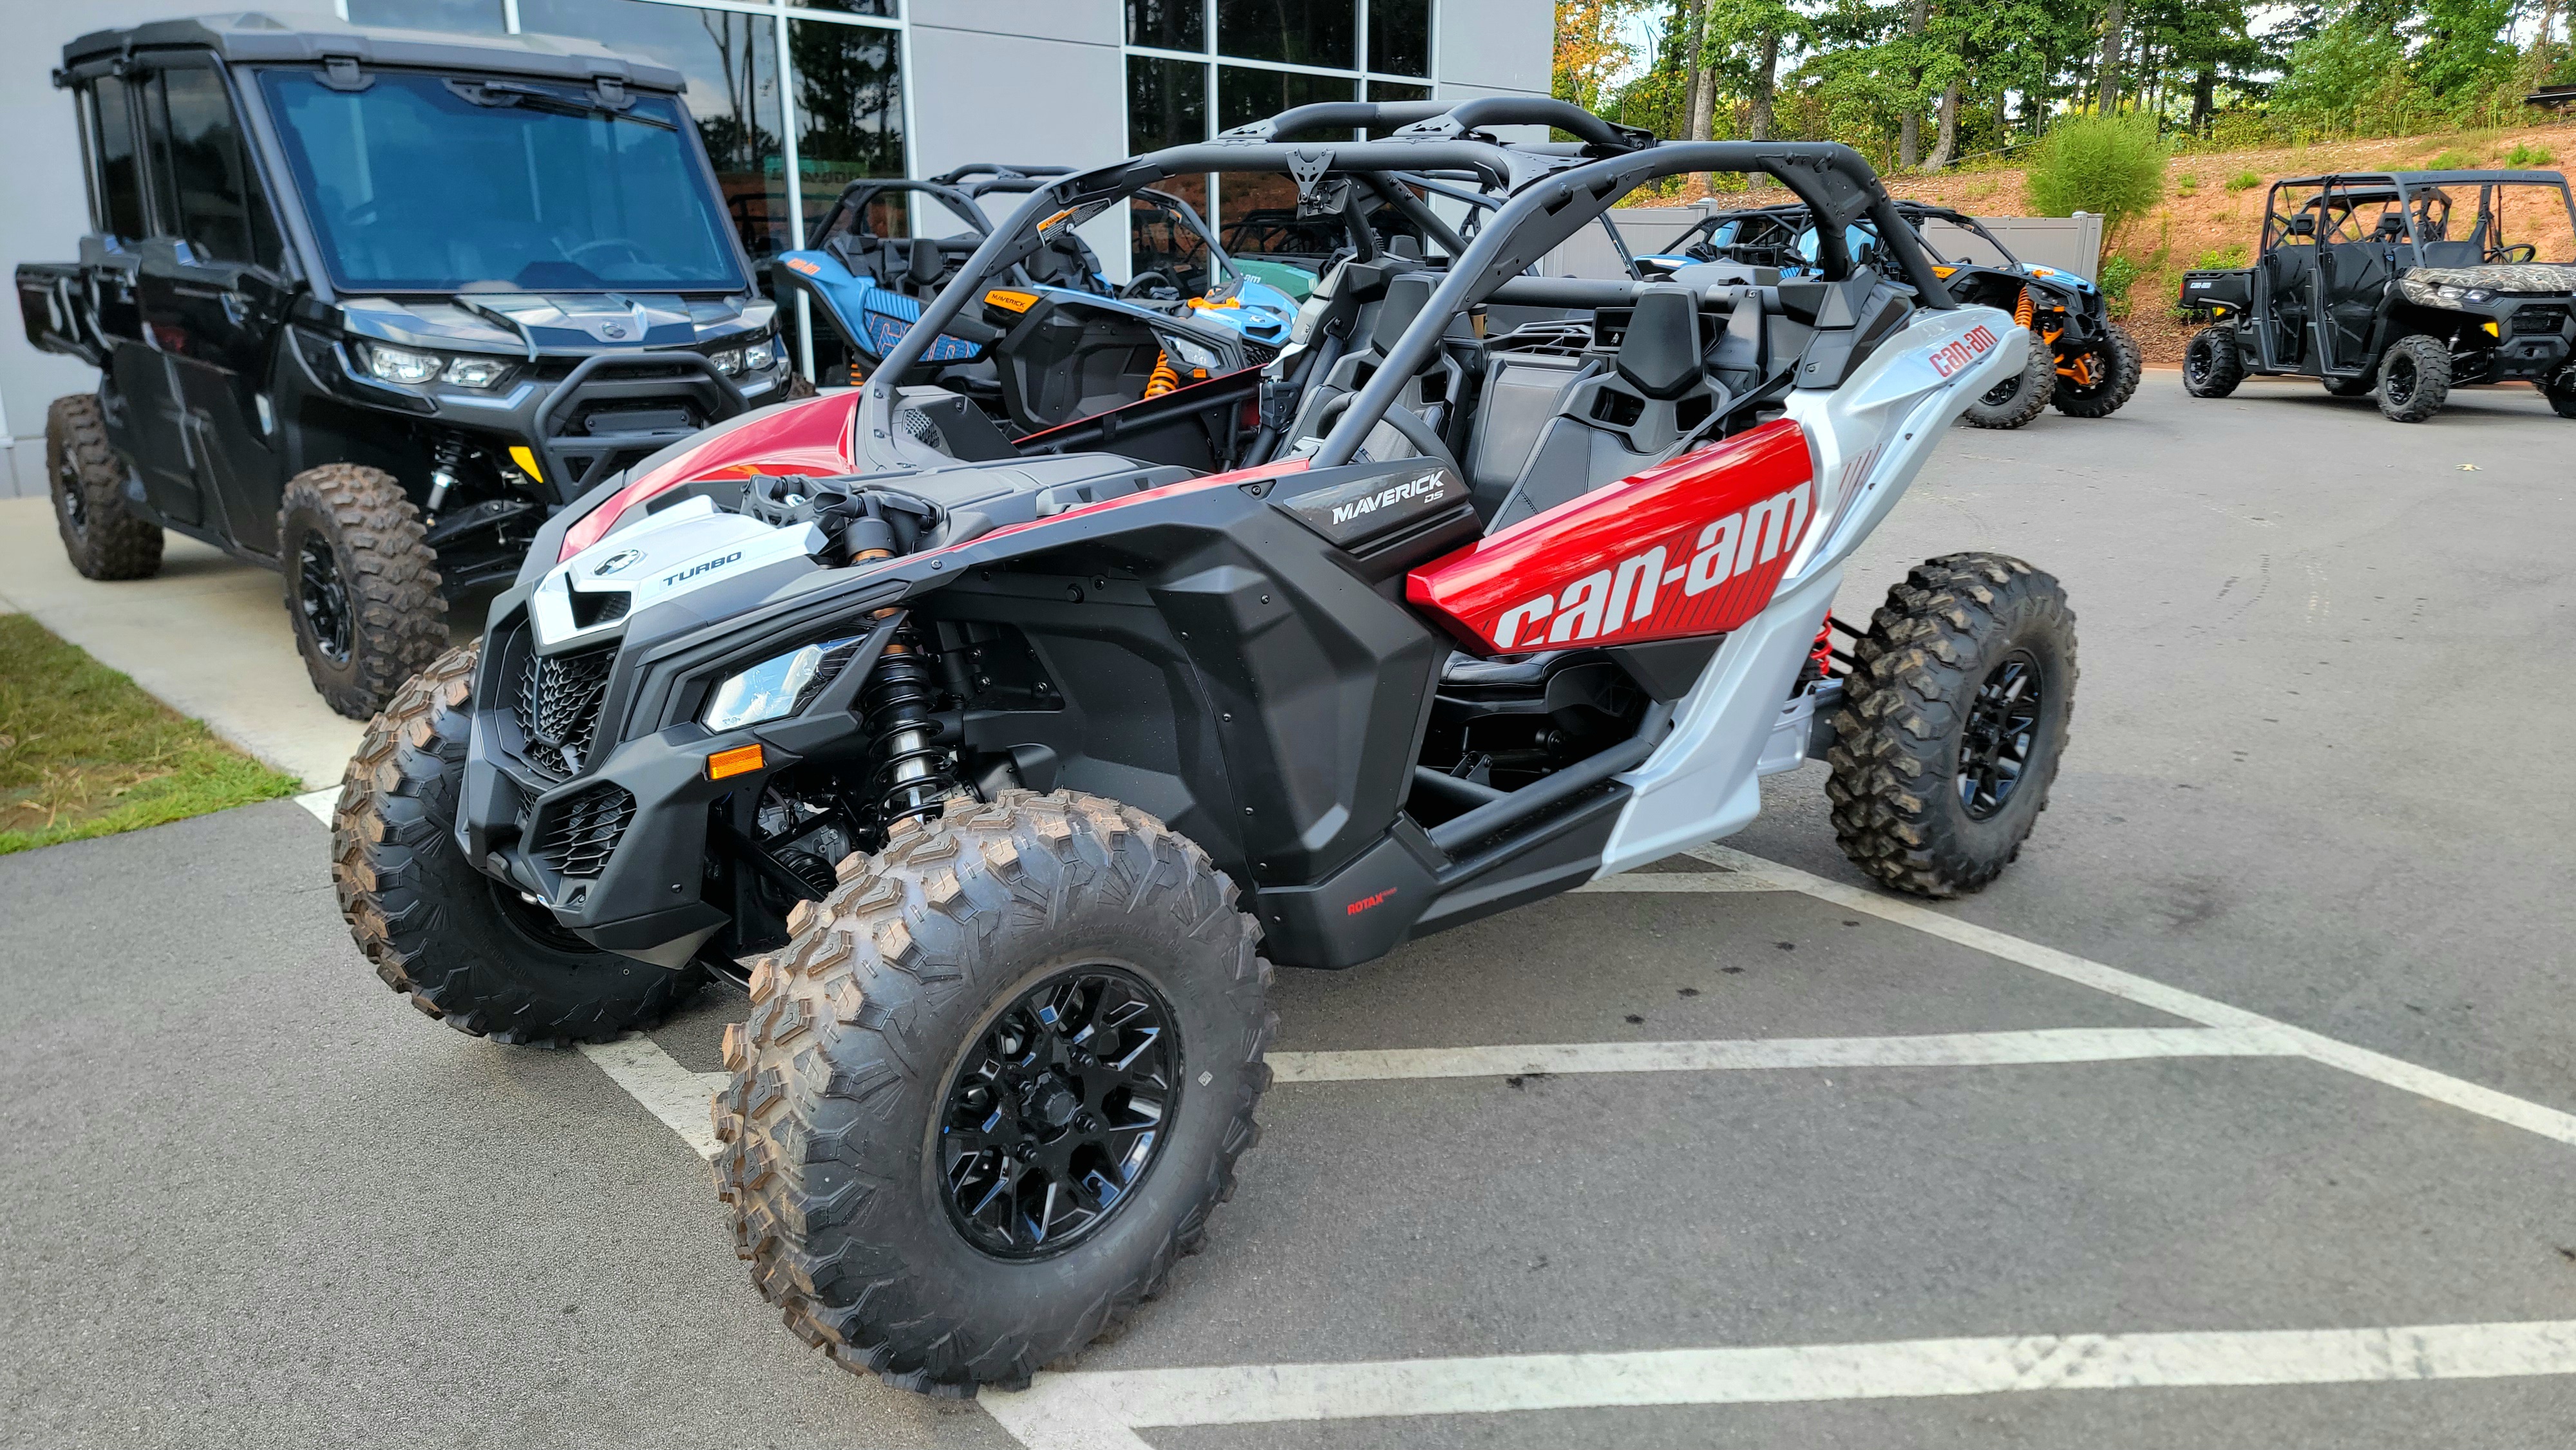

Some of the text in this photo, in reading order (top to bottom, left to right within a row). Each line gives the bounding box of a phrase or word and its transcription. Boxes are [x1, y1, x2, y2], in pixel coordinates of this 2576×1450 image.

[992, 294, 1026, 308] MAVERICK
[1929, 325, 1998, 377] can-am
[1332, 470, 1444, 525] MAVERICK
[1424, 490, 1444, 504] DS
[663, 551, 742, 586] TURBO
[1493, 480, 1812, 648] can-am
[1347, 892, 1383, 916] ROTAX
